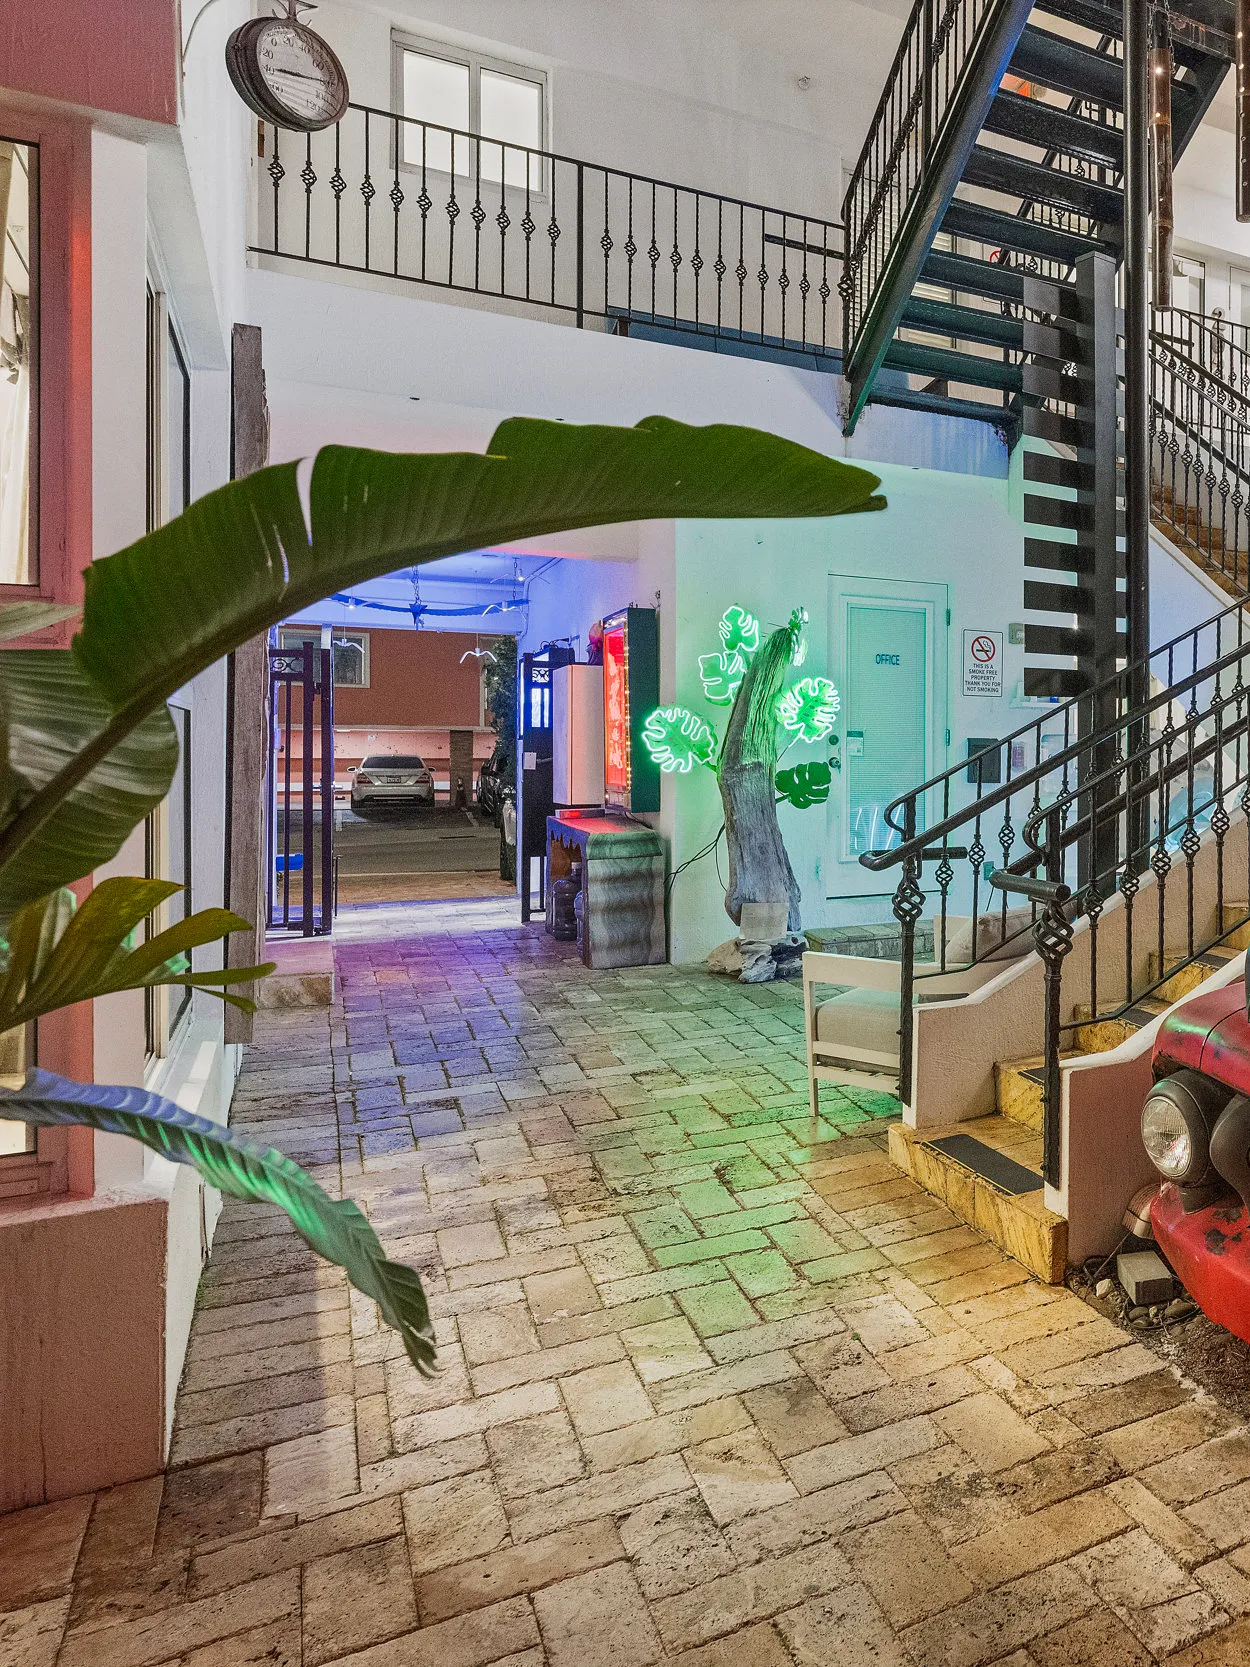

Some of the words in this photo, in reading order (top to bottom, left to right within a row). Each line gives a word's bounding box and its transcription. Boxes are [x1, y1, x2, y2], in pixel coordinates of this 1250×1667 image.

[270, 38, 278, 47] 0
[282, 37, 295, 48] 20
[298, 43, 311, 55] 40
[312, 59, 325, 71] 60
[876, 654, 900, 665] OFFICE
